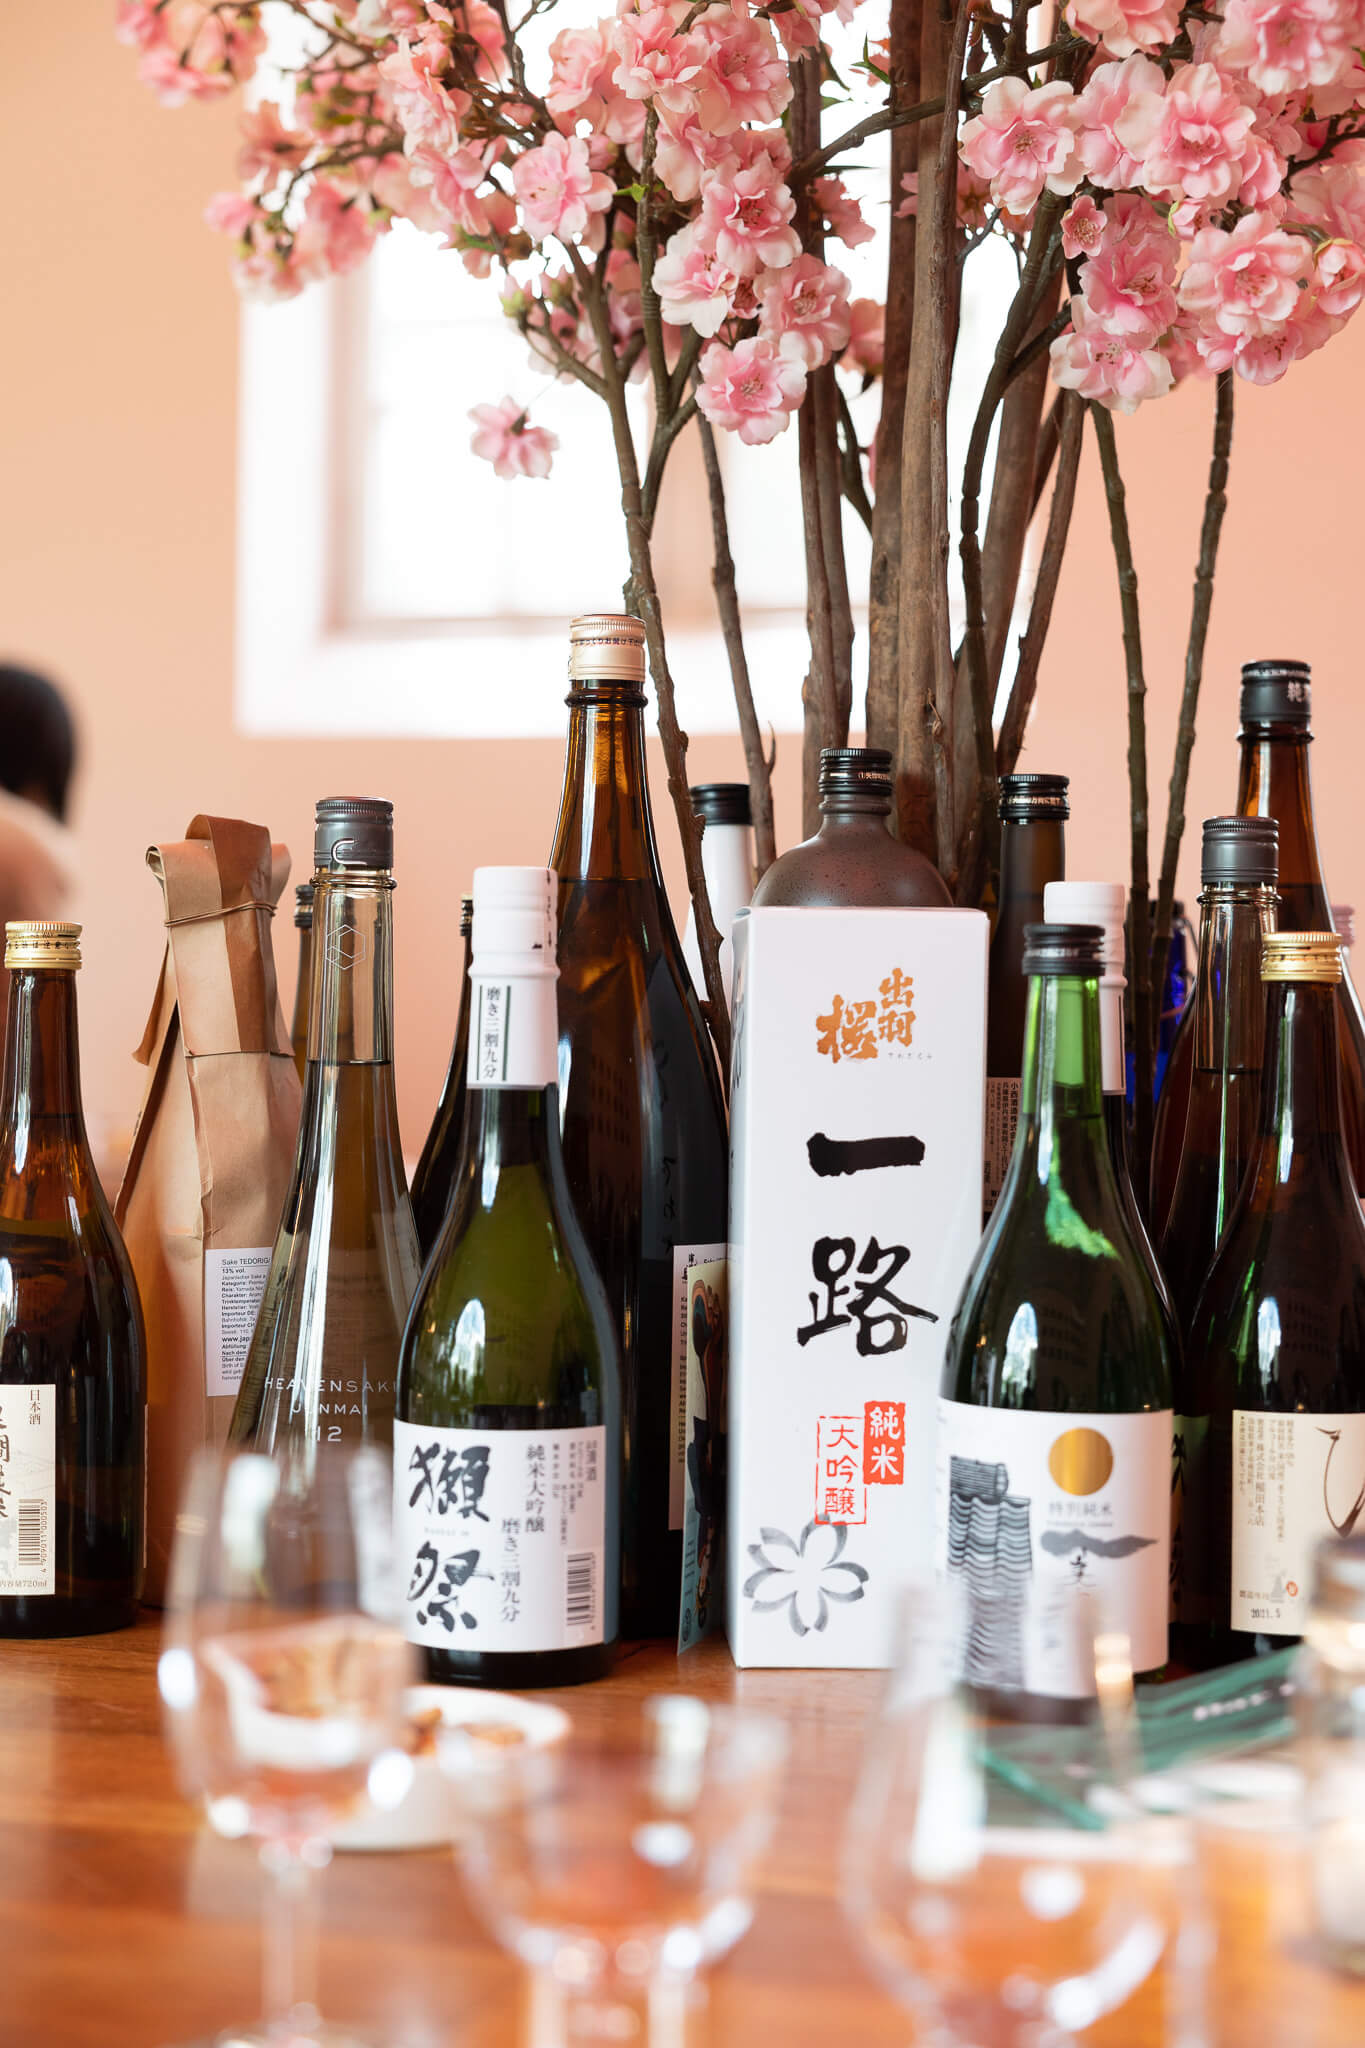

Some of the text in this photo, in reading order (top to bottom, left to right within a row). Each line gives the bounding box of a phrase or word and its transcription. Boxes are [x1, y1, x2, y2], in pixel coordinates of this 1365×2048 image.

[484, 986, 501, 1080] 磨き三割九分
[796, 1132, 940, 1358] 一路
[29, 1389, 41, 1425] 日本酒
[869, 1405, 902, 1480] 純米
[825, 1423, 859, 1516] 大吟醸
[501, 1517, 520, 1623] 磨き三割九分
